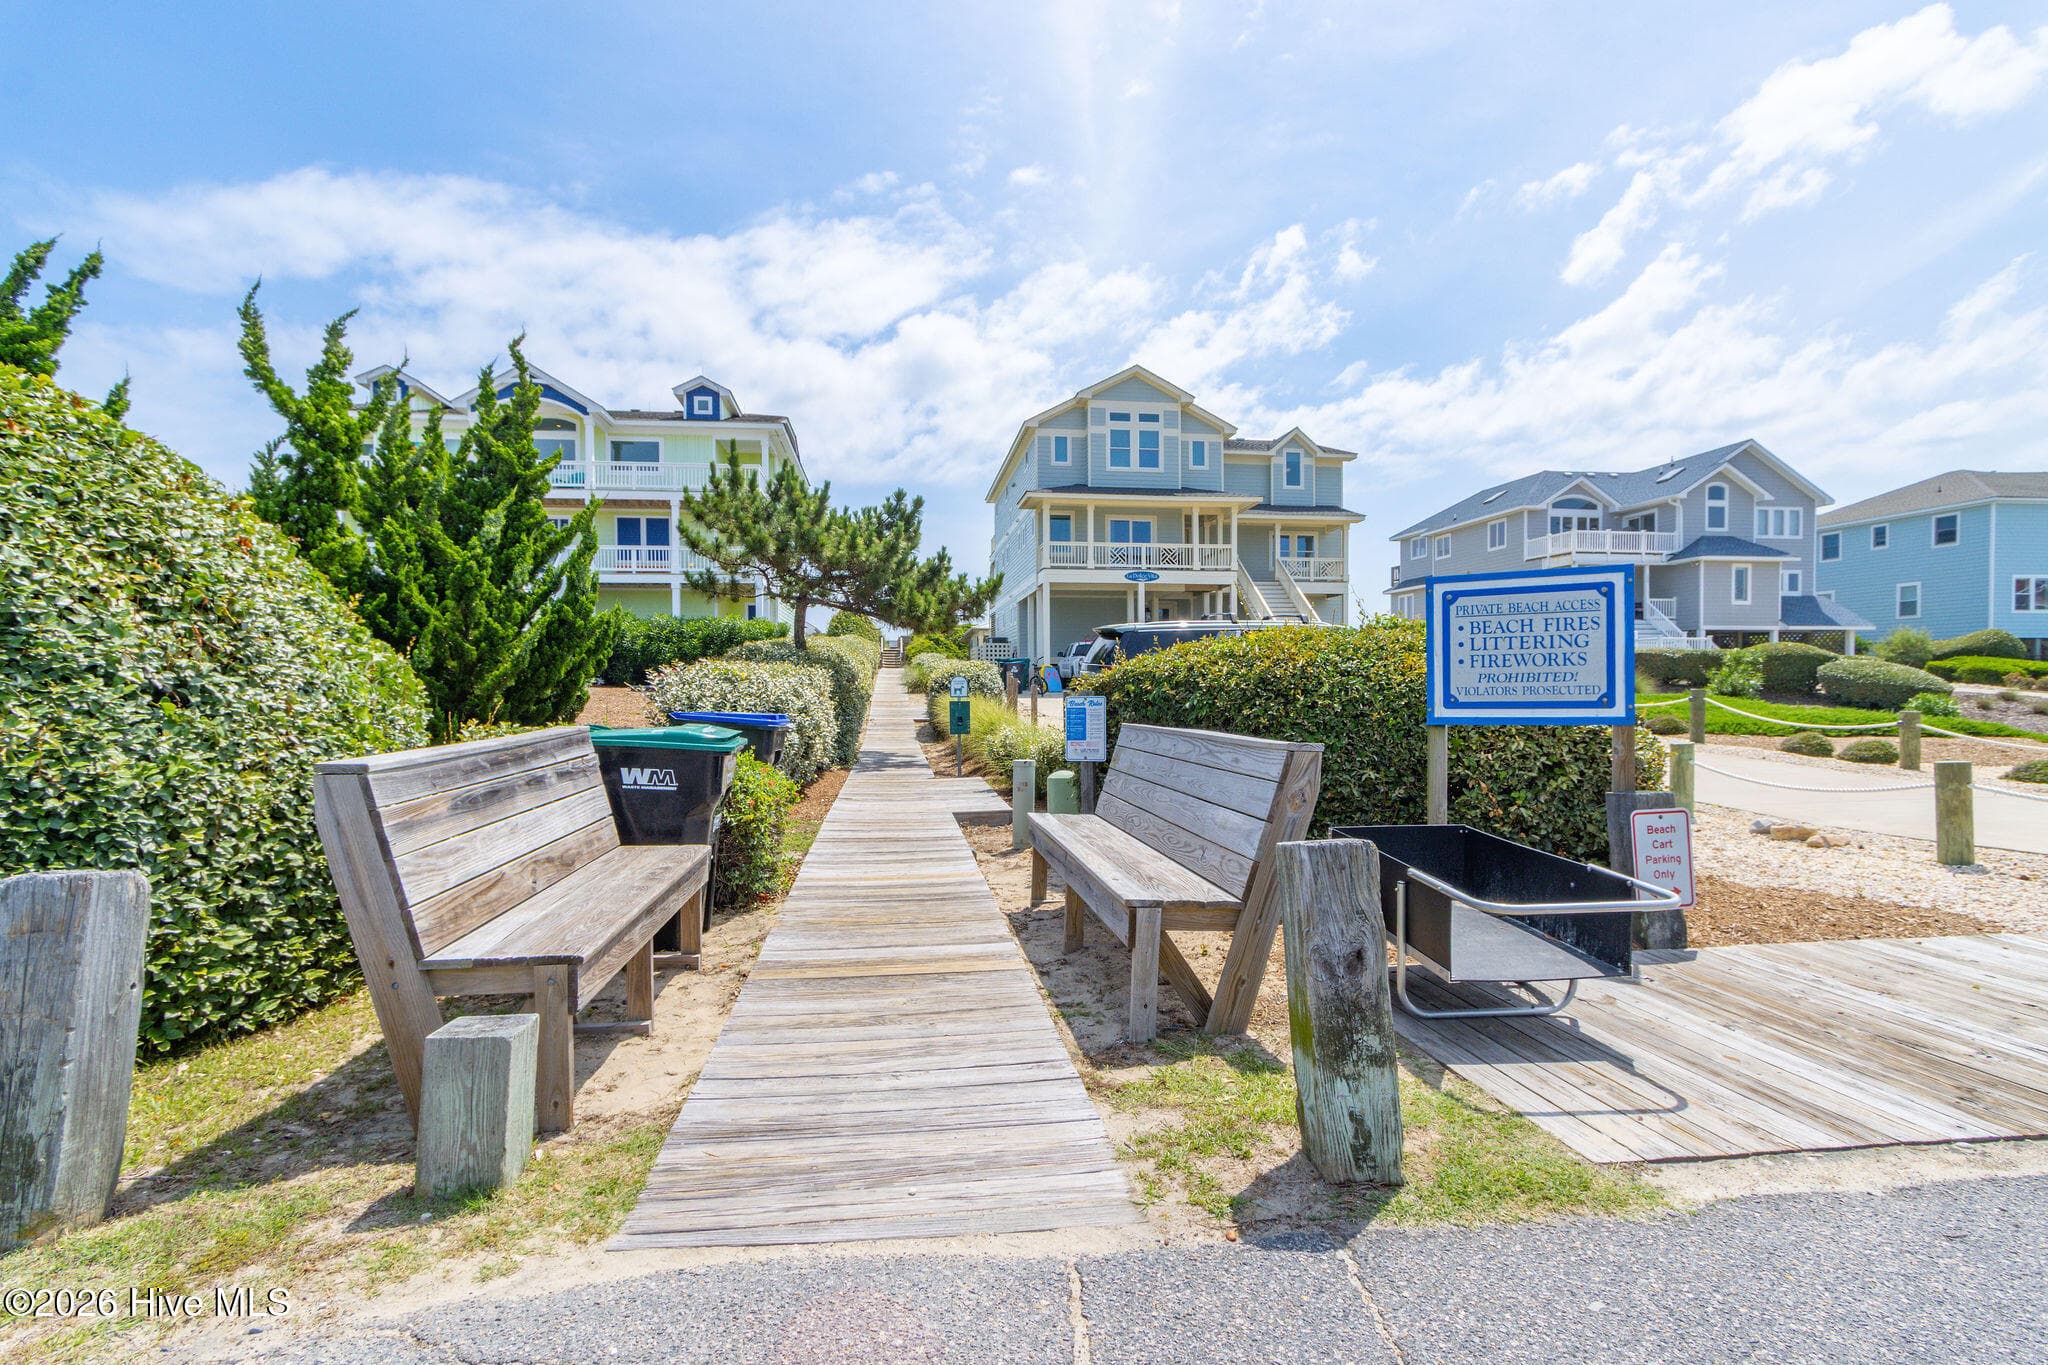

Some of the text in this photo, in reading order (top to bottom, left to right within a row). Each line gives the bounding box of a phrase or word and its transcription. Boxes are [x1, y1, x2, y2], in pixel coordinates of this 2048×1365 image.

[1456, 599, 1601, 616] PRIVATE BEACH ACCESS
[1470, 616, 1601, 635] BEACH FIRES
[1470, 633, 1590, 651] LITTERING
[1470, 651, 1587, 668] FIREWORKS
[1477, 671, 1579, 684] PROHIBITED!
[1456, 685, 1601, 697] VIOLATORS PROSECUTED
[620, 768, 676, 785] WM
[1647, 825, 1676, 835] Beach
[1652, 839, 1673, 849] Cart
[1645, 855, 1682, 865] Parking
[1653, 870, 1675, 880] Only
